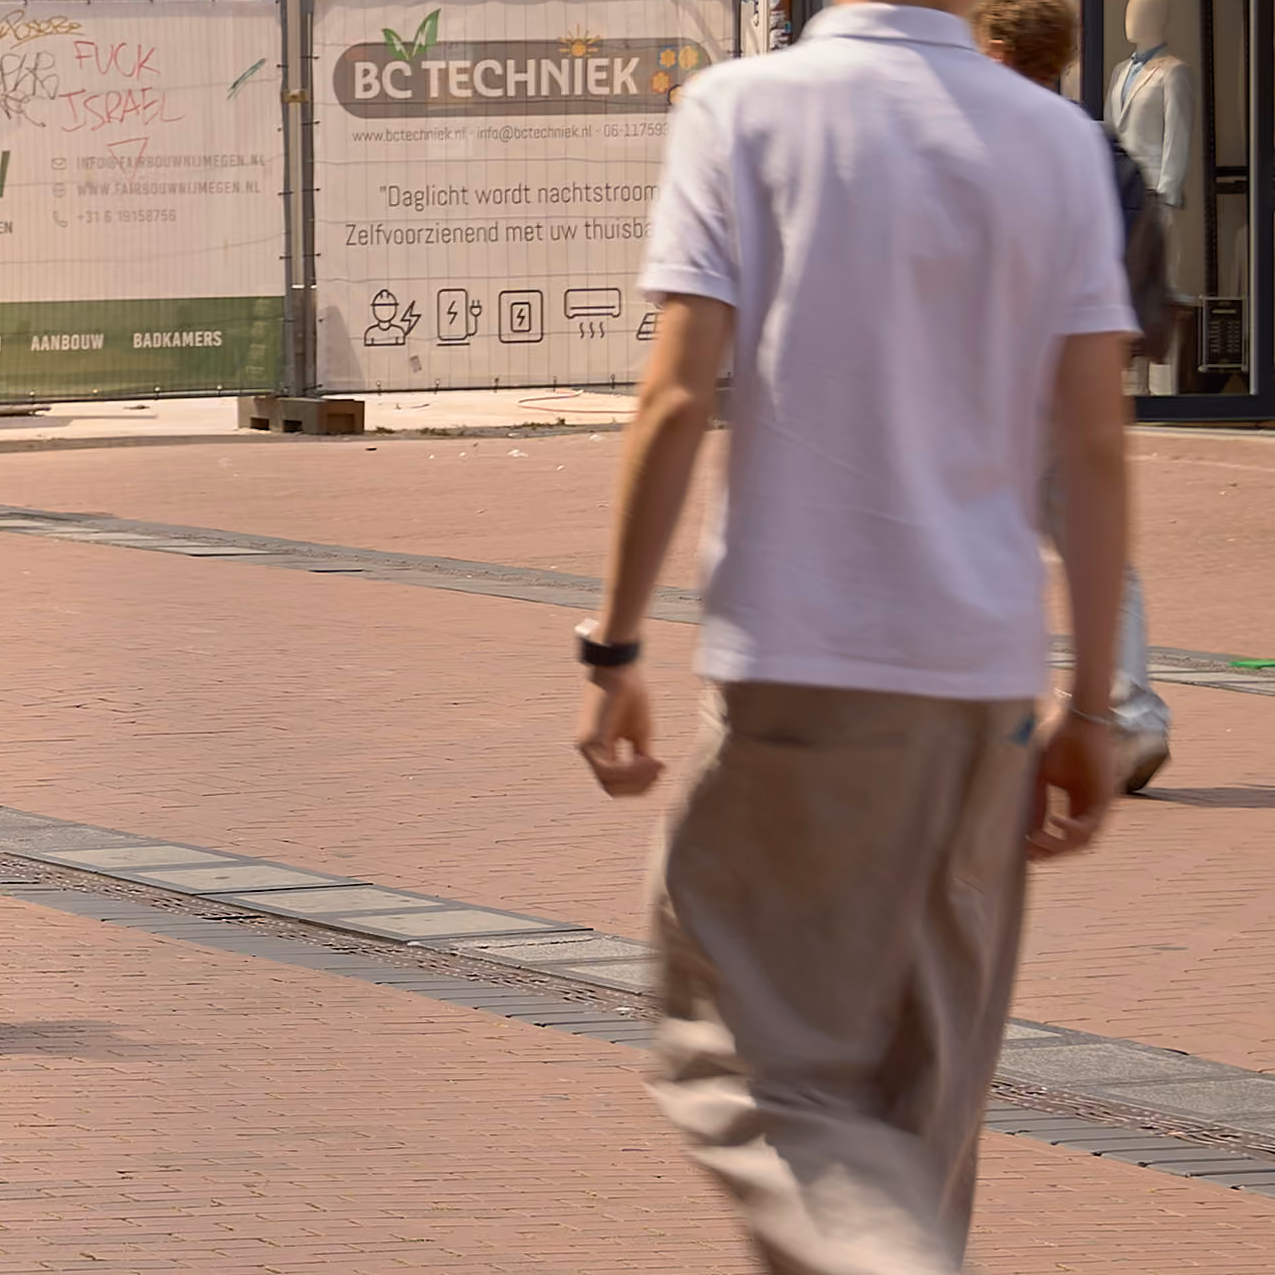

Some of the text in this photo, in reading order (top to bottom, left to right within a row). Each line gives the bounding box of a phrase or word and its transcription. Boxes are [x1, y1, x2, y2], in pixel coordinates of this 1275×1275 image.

[74, 40, 161, 80] FUCK
[354, 57, 641, 100] BC TECHNIEK
[58, 86, 186, 132] ISRAEL
[475, 183, 531, 208] wordt
[346, 221, 500, 246] Zelfvoorzienend
[505, 223, 545, 243] met
[550, 224, 578, 241] uw
[31, 333, 105, 353] AANBOUW
[133, 330, 223, 349] BADKAMERS
